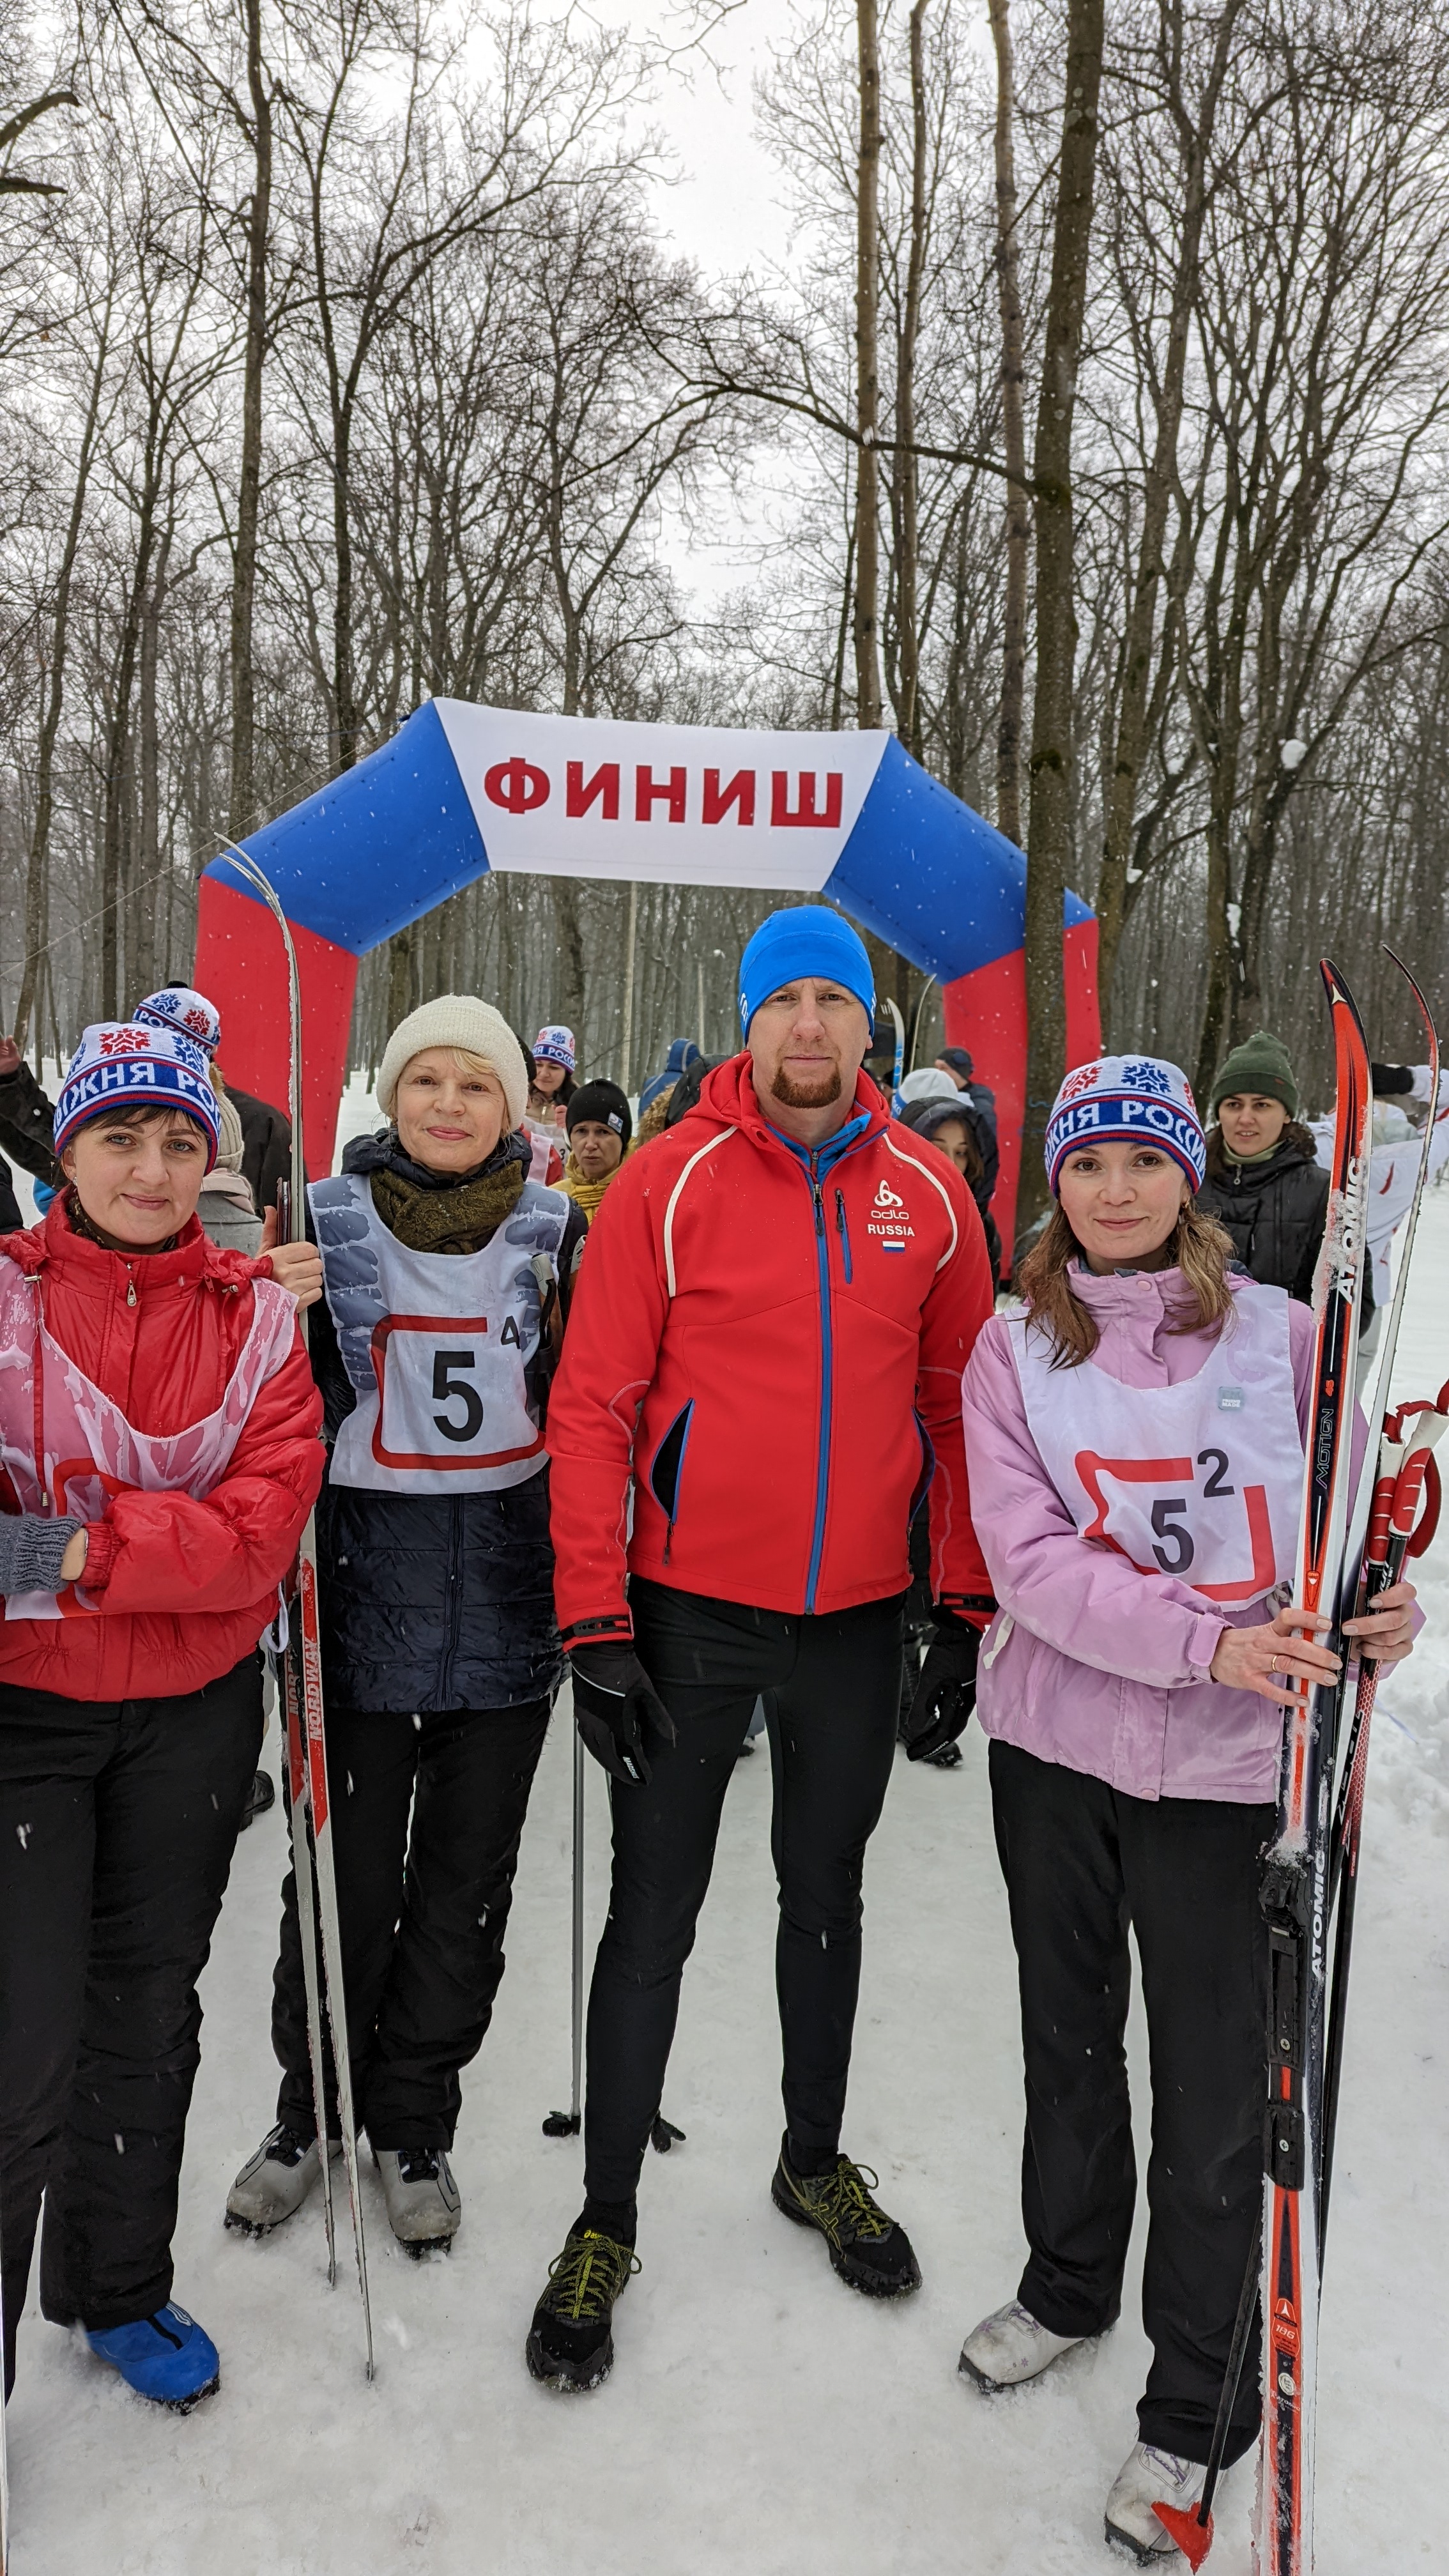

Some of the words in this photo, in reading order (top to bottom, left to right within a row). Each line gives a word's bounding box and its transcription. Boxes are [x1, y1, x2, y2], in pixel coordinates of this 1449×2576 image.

[484, 757, 843, 828] ФИНИШ
[867, 1223, 916, 1237] RUSSIA
[871, 1209, 910, 1220] odlo
[501, 1315, 521, 1350] 4
[433, 1350, 484, 1443] 5
[1325, 1379, 1335, 1397] 45
[1197, 1448, 1236, 1498] 2
[1315, 1408, 1335, 1490] MOTION
[1151, 1498, 1195, 1574] 5
[288, 1660, 300, 1716] NOR
[304, 1636, 323, 1742] NORDWAY
[1312, 1850, 1326, 1979] ATOMIC
